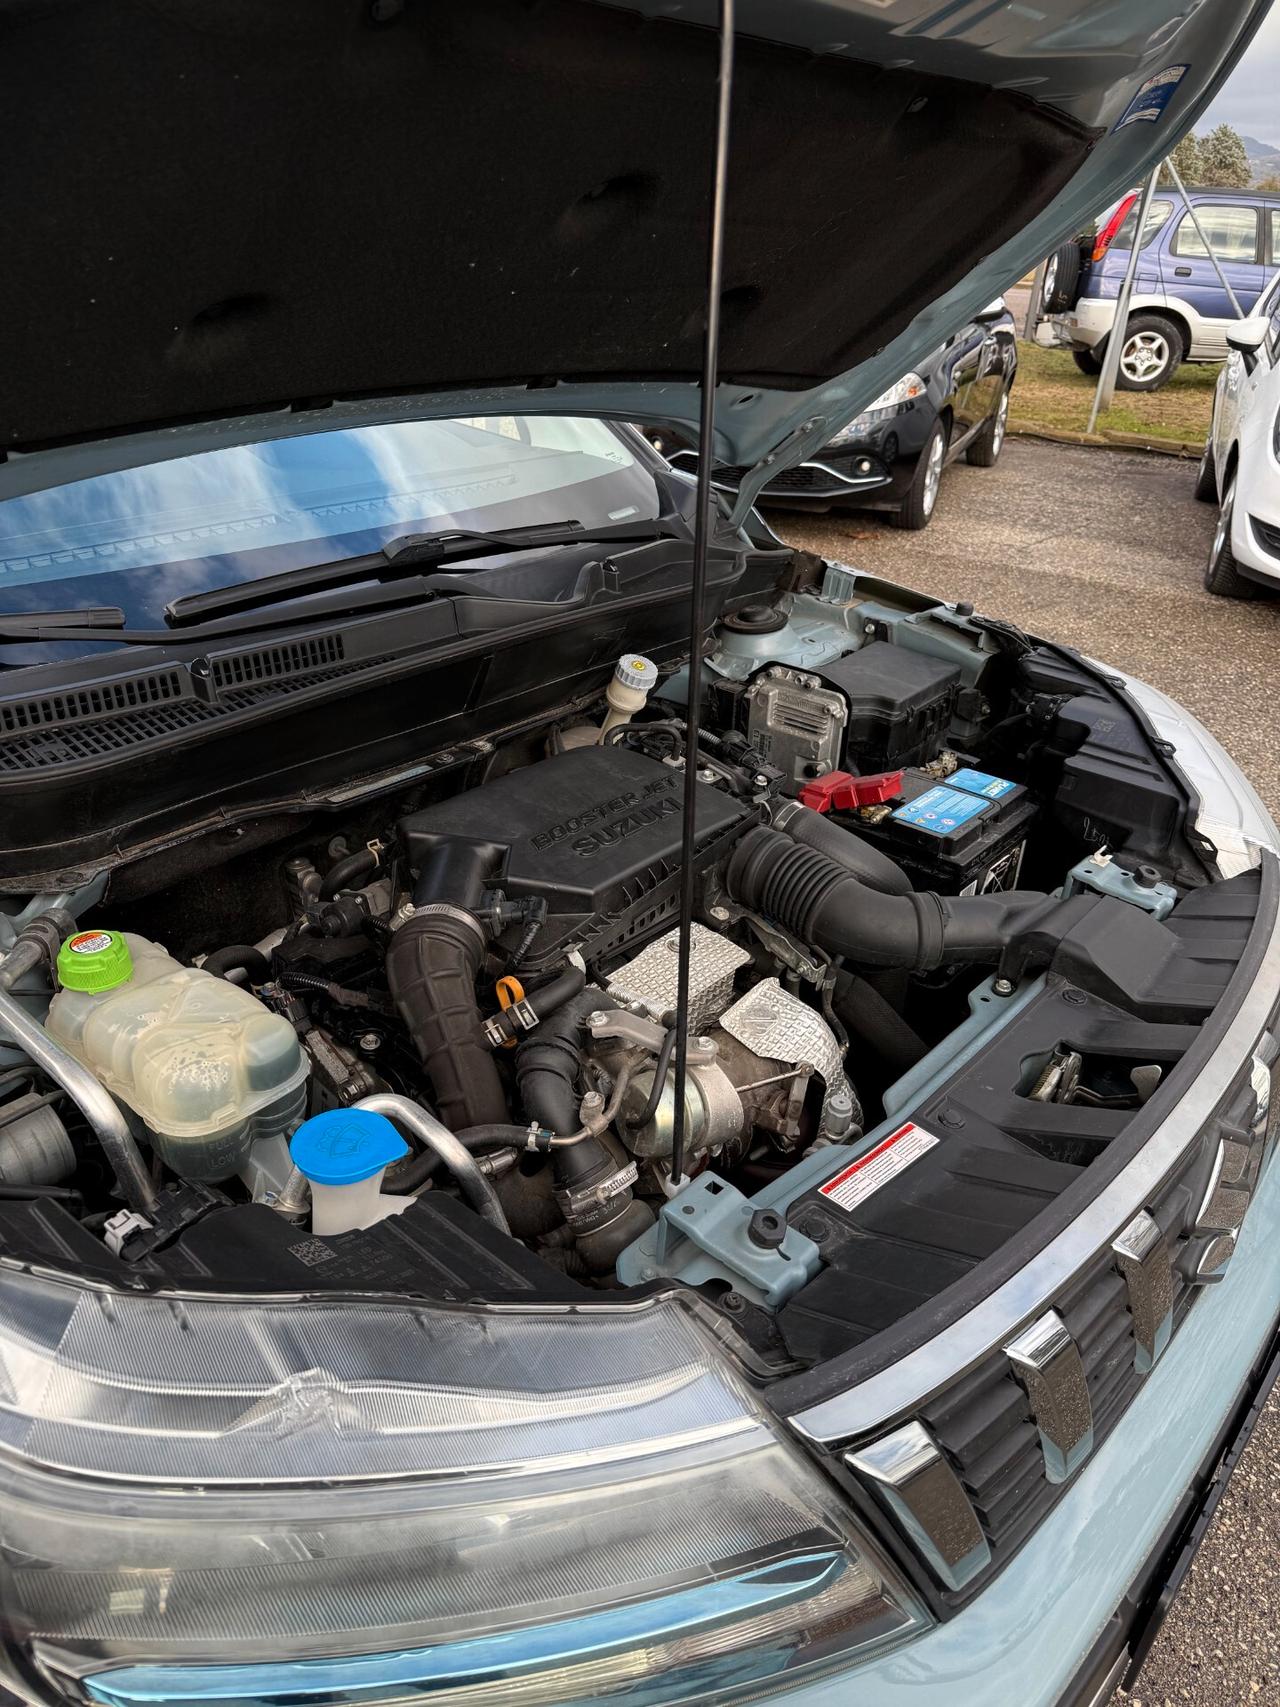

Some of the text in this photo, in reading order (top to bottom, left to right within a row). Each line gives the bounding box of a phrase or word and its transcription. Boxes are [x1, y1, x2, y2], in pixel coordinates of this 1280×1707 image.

[531, 776, 678, 850] BOOSTER JET
[571, 796, 684, 857] SUZUKI
[211, 1151, 236, 1168] LOW
